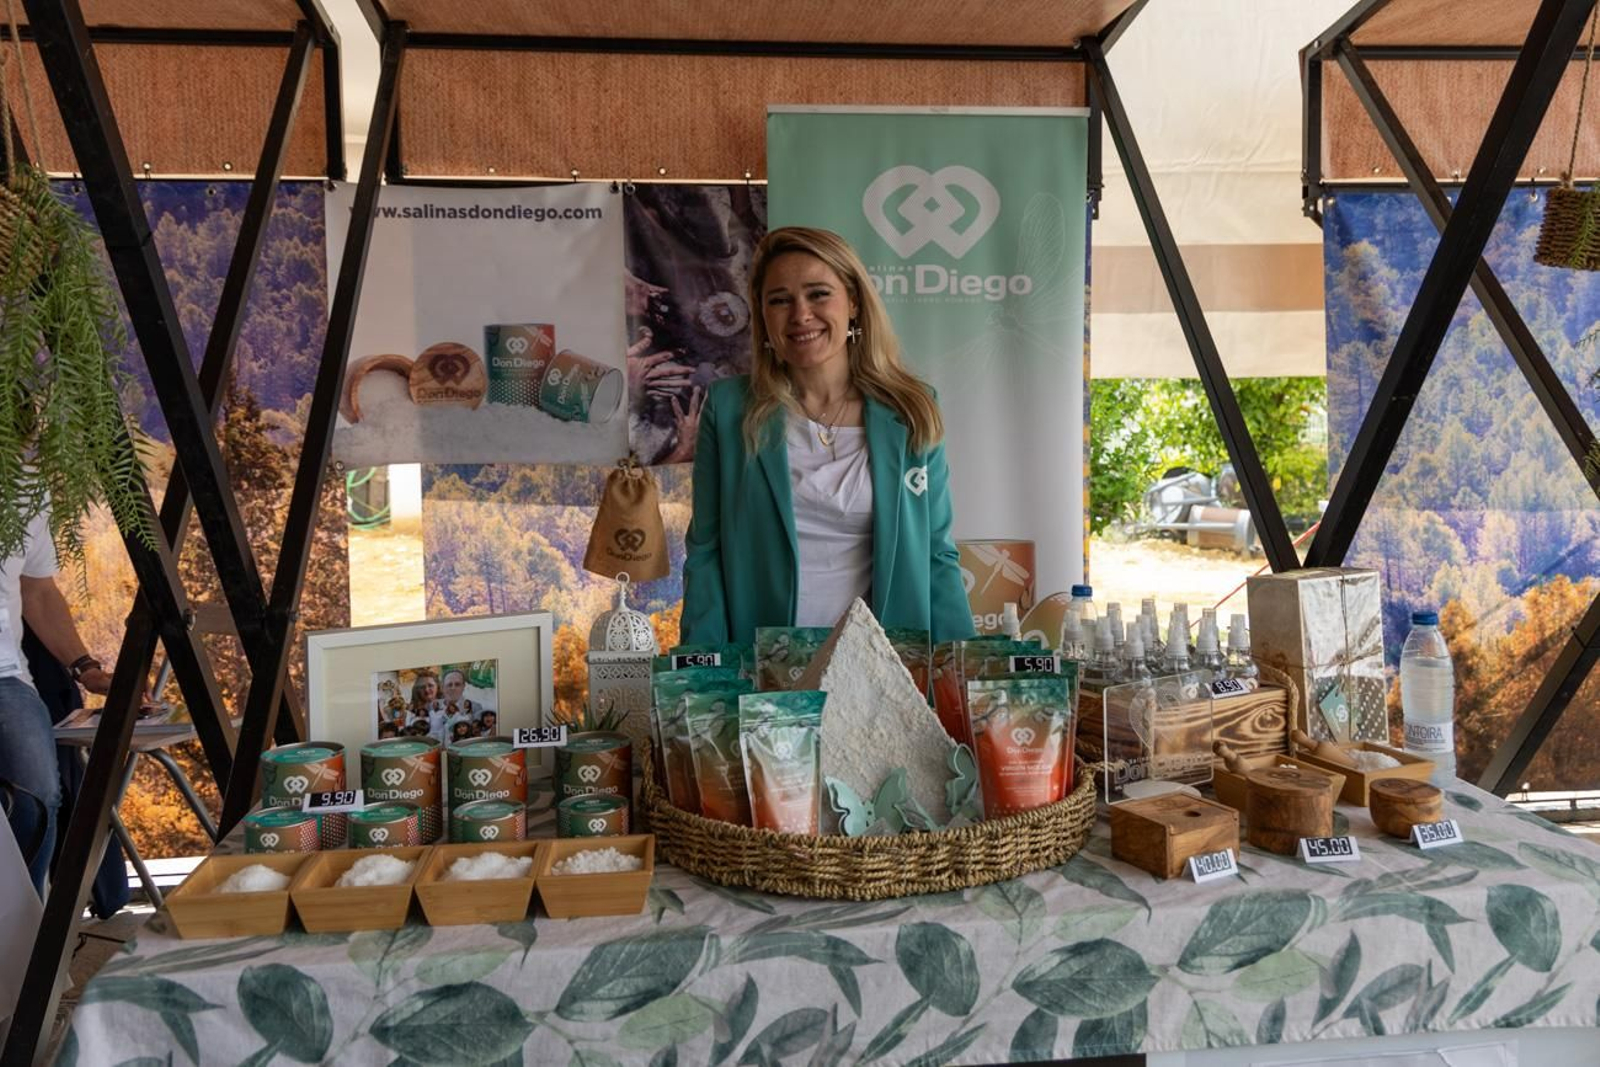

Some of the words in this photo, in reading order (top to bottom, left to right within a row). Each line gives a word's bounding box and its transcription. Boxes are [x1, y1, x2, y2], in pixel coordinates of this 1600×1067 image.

[915, 264, 1033, 301] Diego
[368, 787, 388, 800] Don
[389, 788, 424, 800] Diego
[454, 787, 475, 800] Don
[475, 788, 510, 801] Diego
[1308, 837, 1351, 855] 45.00
[1195, 851, 1230, 873] 40.00
